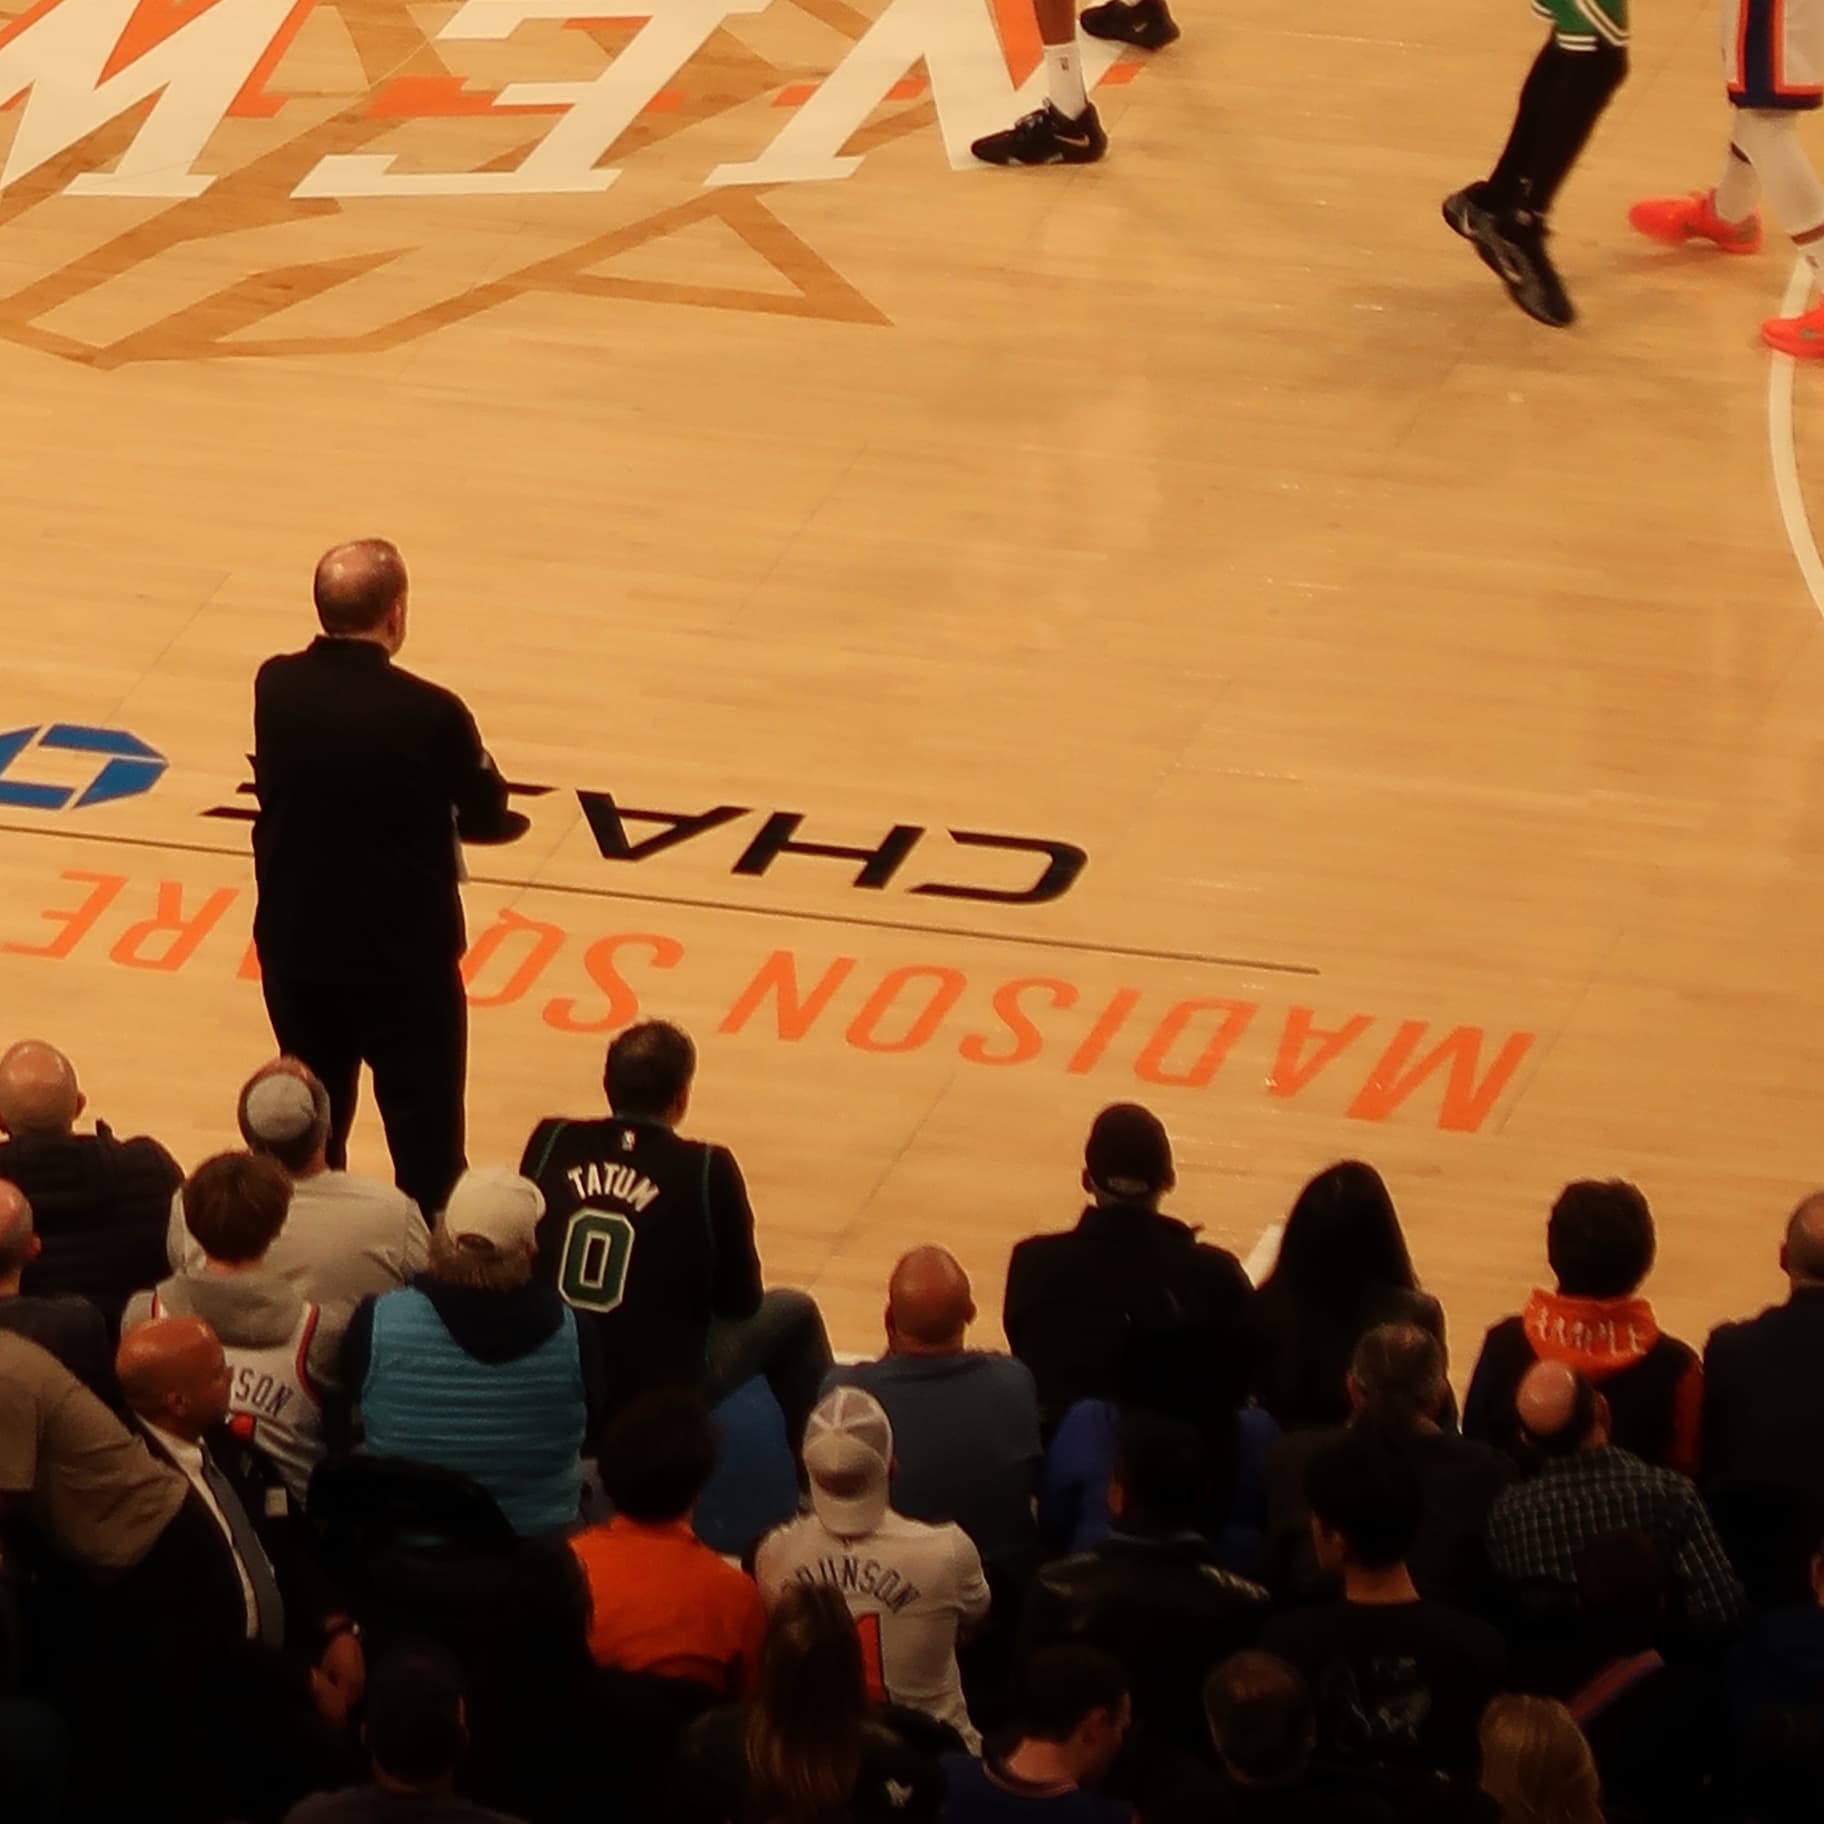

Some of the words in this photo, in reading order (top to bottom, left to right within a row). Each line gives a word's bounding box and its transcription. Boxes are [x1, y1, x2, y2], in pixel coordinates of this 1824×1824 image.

[0, 868, 687, 1036] SQRE
[718, 947, 1536, 1135] MADISON
[568, 1162, 663, 1214] TATUM
[558, 1206, 636, 1314] 0
